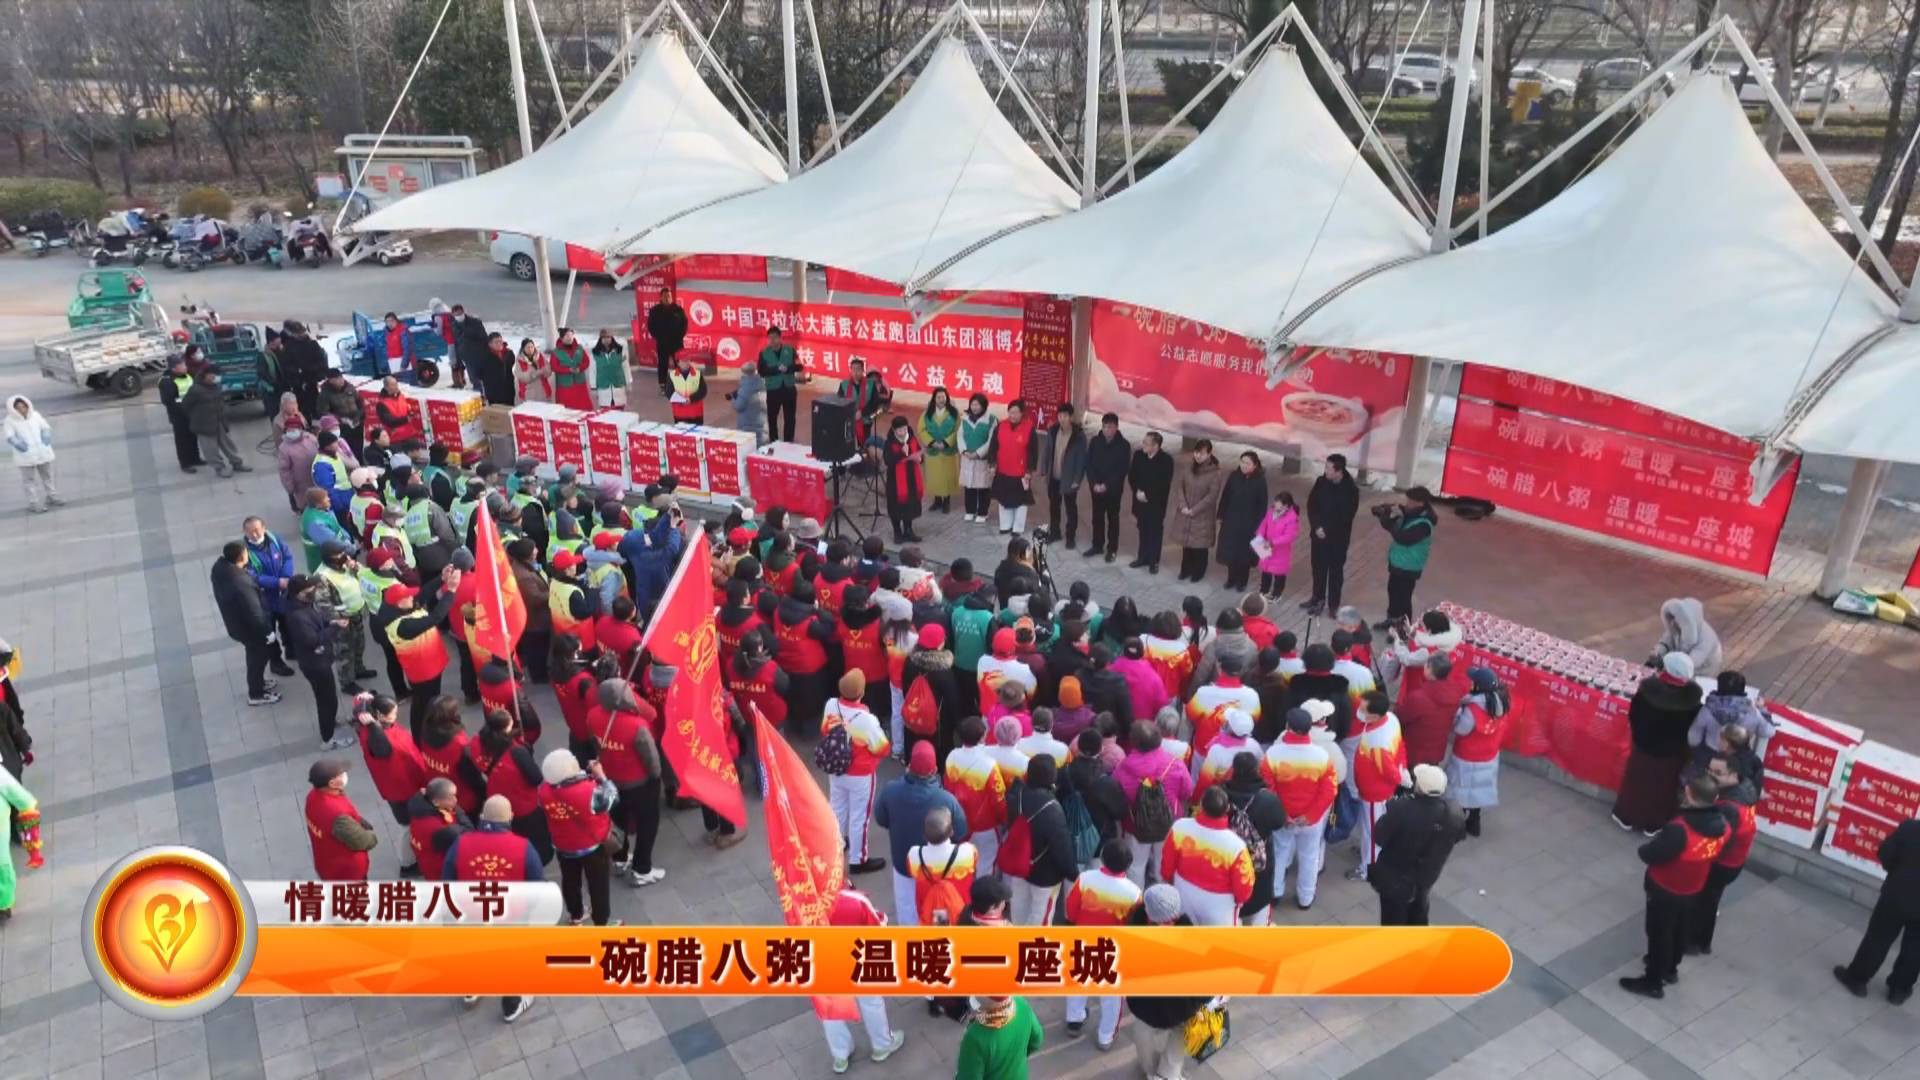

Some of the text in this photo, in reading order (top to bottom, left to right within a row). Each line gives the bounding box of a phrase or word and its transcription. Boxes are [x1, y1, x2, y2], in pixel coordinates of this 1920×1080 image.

[1461, 465, 1755, 550] 一碗腊八粥 温暖一座城
